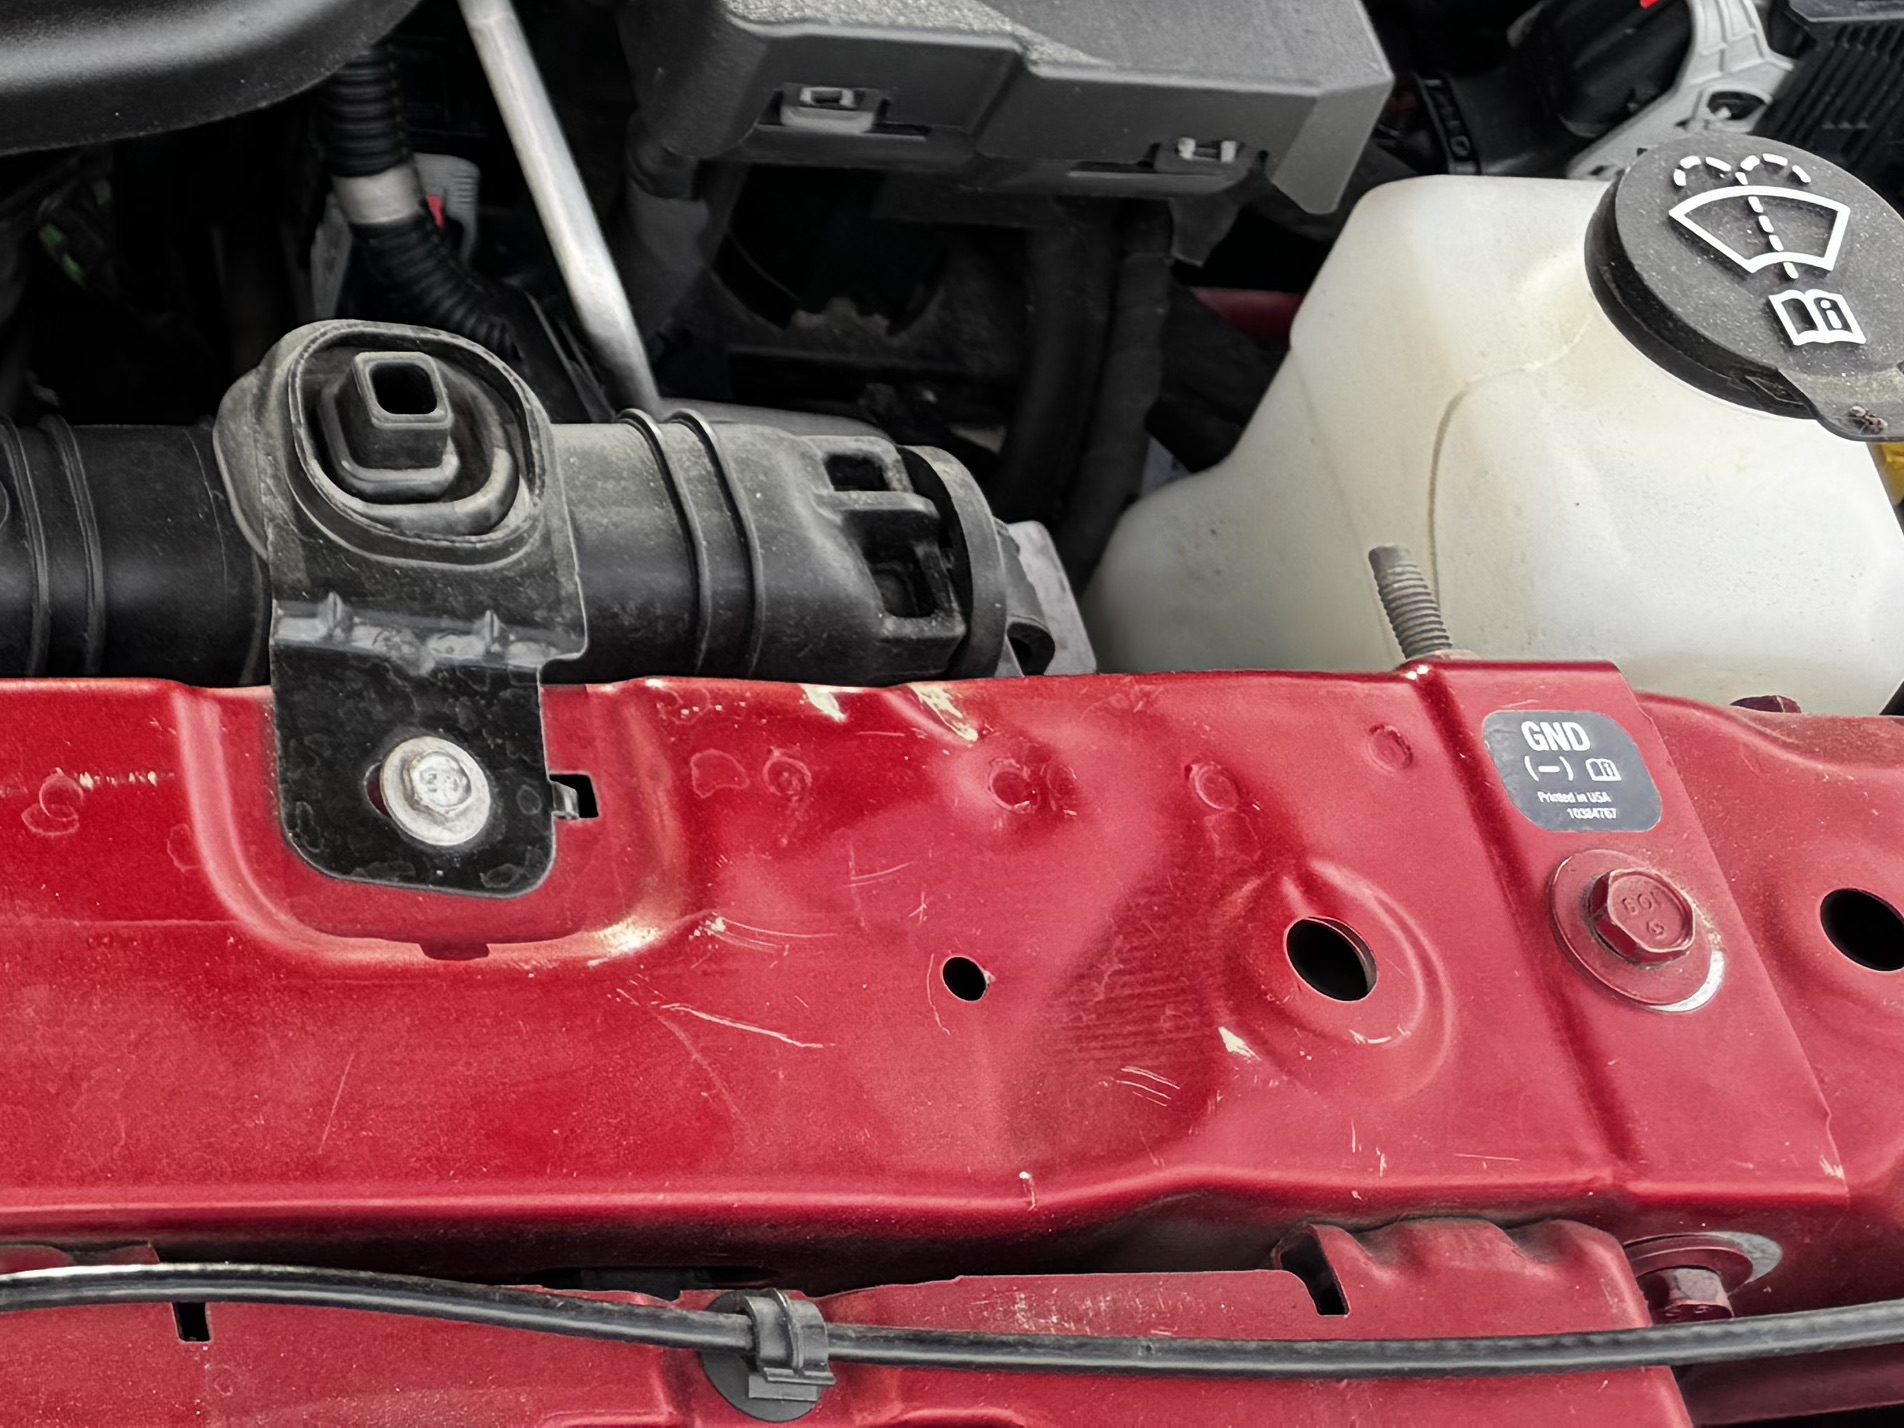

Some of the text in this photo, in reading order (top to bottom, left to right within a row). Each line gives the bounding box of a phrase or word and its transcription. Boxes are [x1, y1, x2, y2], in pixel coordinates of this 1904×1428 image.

[1520, 720, 1591, 752] GND
[1537, 791, 1612, 804] Printed in USA
